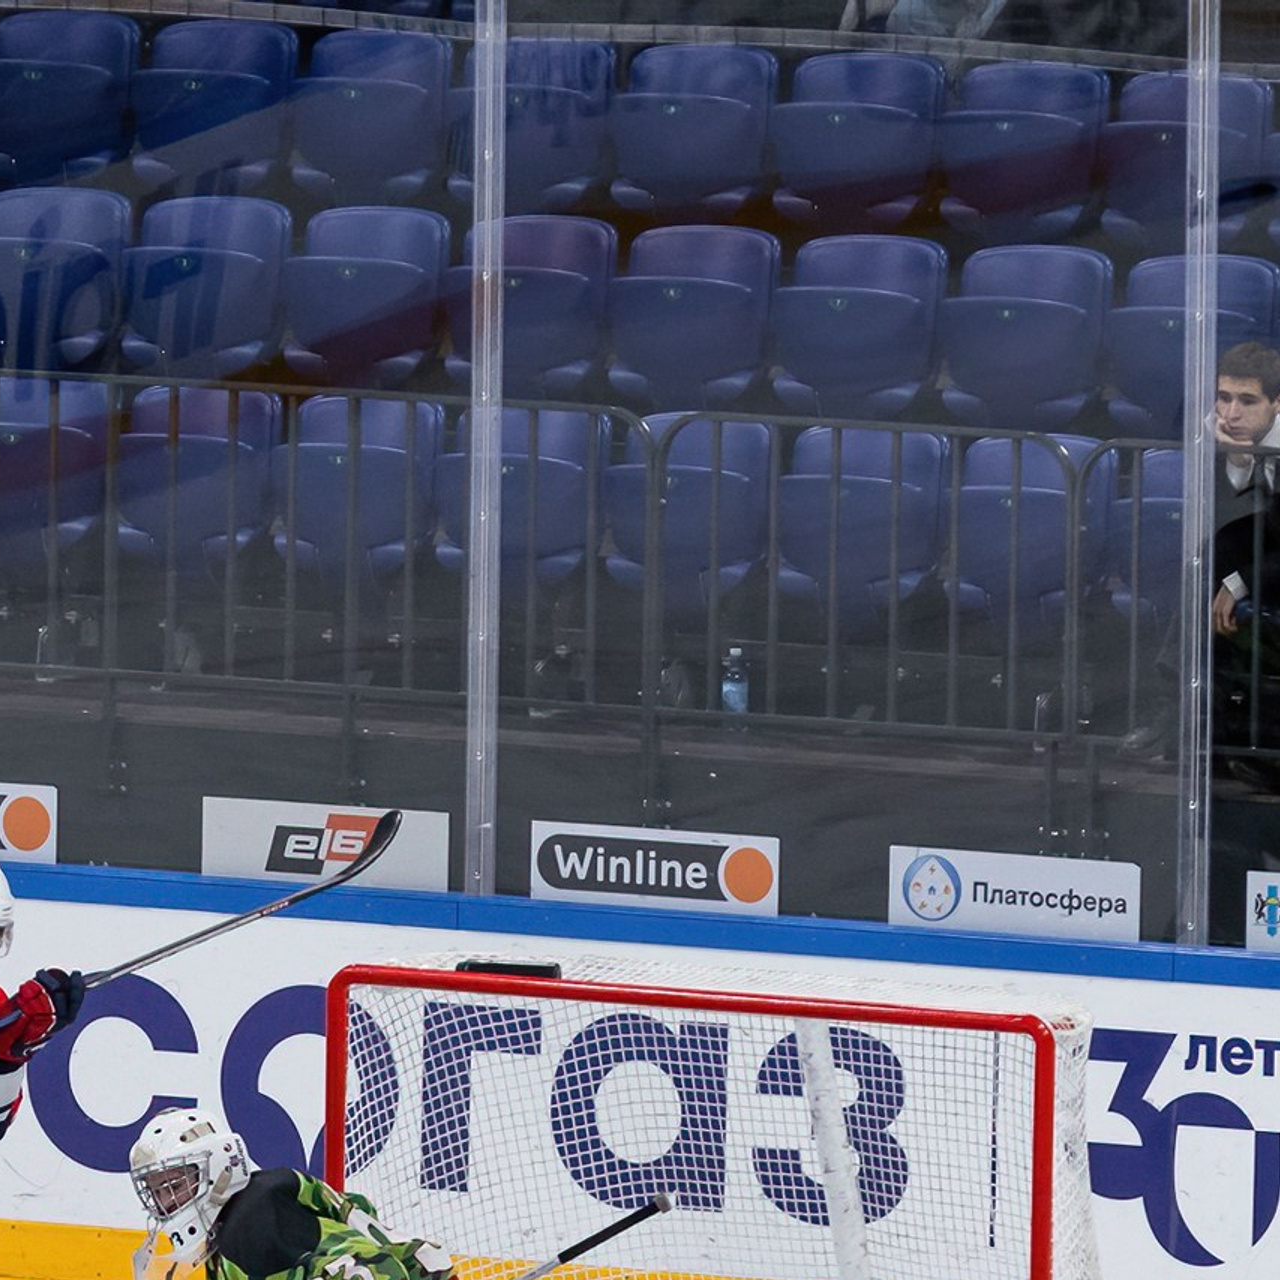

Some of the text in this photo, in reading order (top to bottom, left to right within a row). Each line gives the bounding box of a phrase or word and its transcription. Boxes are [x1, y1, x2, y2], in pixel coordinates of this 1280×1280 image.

[554, 843, 708, 890] Winline
[971, 880, 1128, 916] Платосфера
[1183, 1033, 1280, 1078] лет
